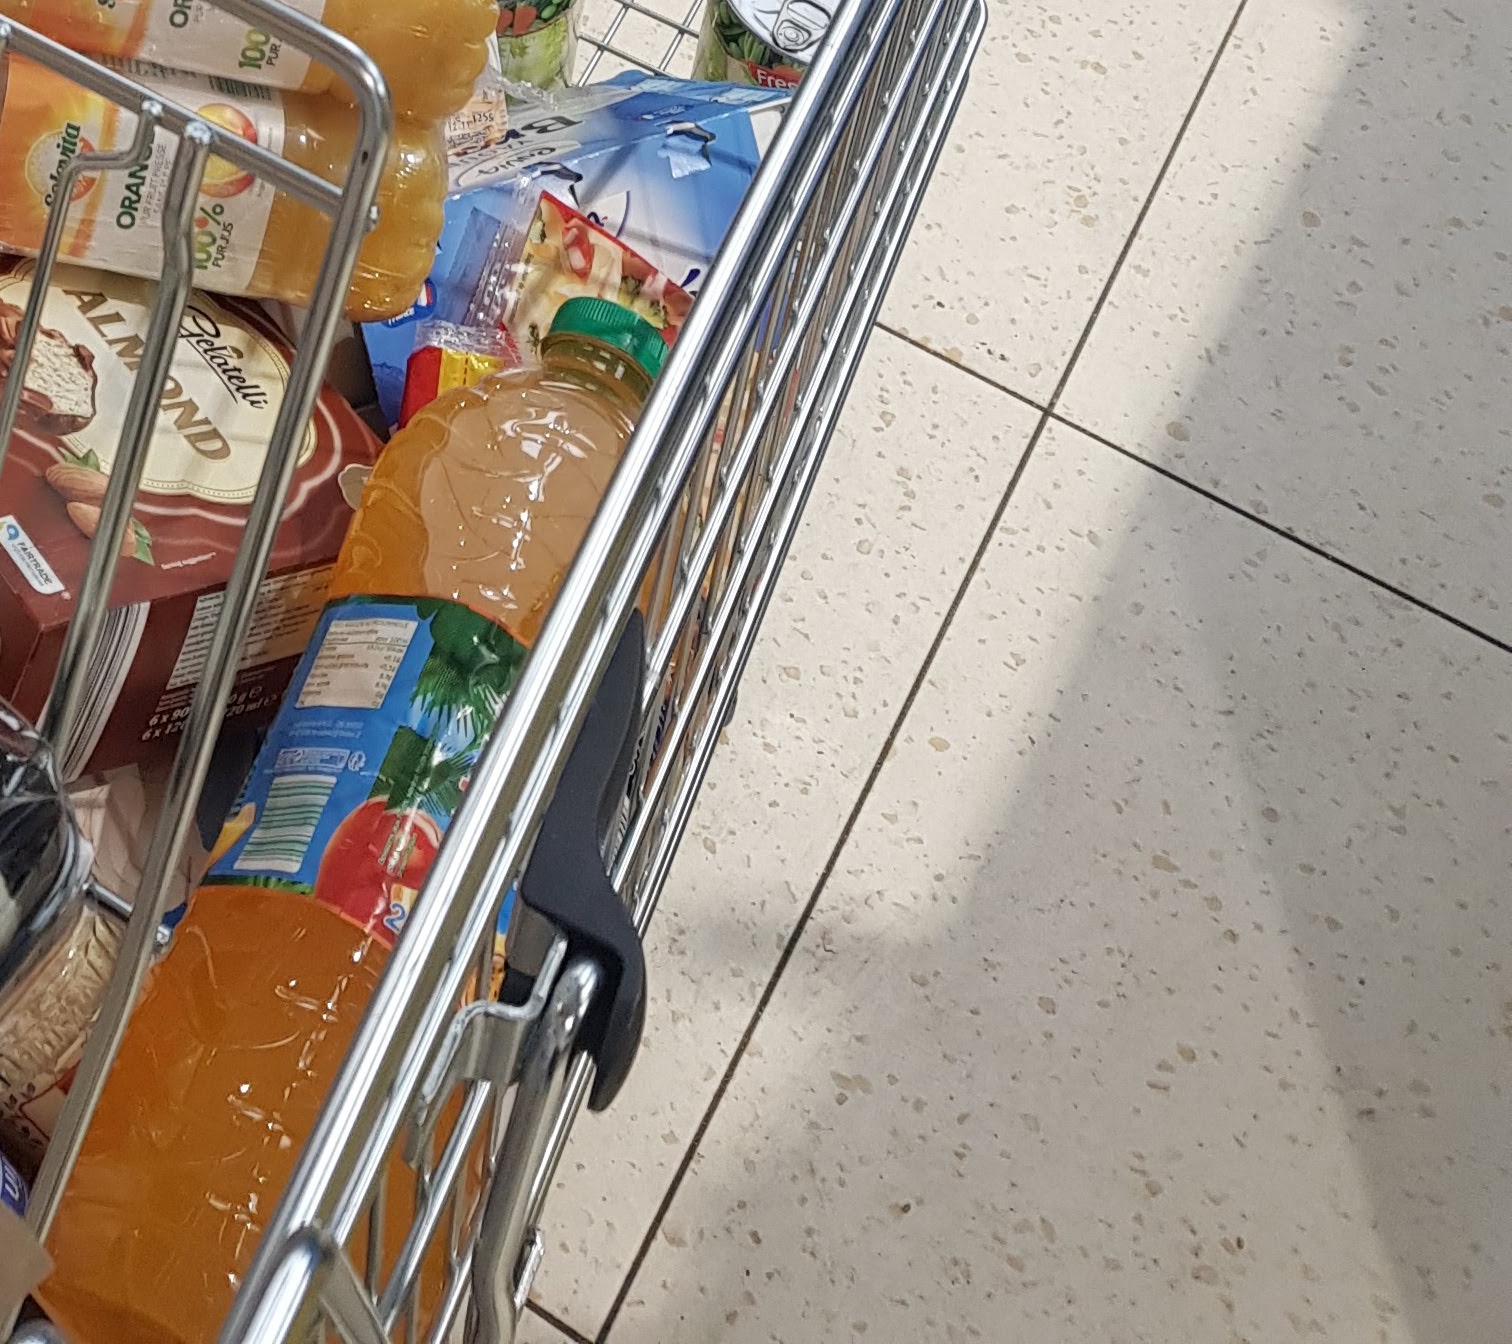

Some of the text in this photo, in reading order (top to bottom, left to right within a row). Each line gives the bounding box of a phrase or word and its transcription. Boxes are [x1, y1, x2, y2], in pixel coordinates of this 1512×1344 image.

[211, 221, 235, 269] PUR JUS
[61, 286, 233, 464] ALMOND
[179, 302, 269, 414] Gelatelli
[14, 538, 57, 587] FAIRTRADE
